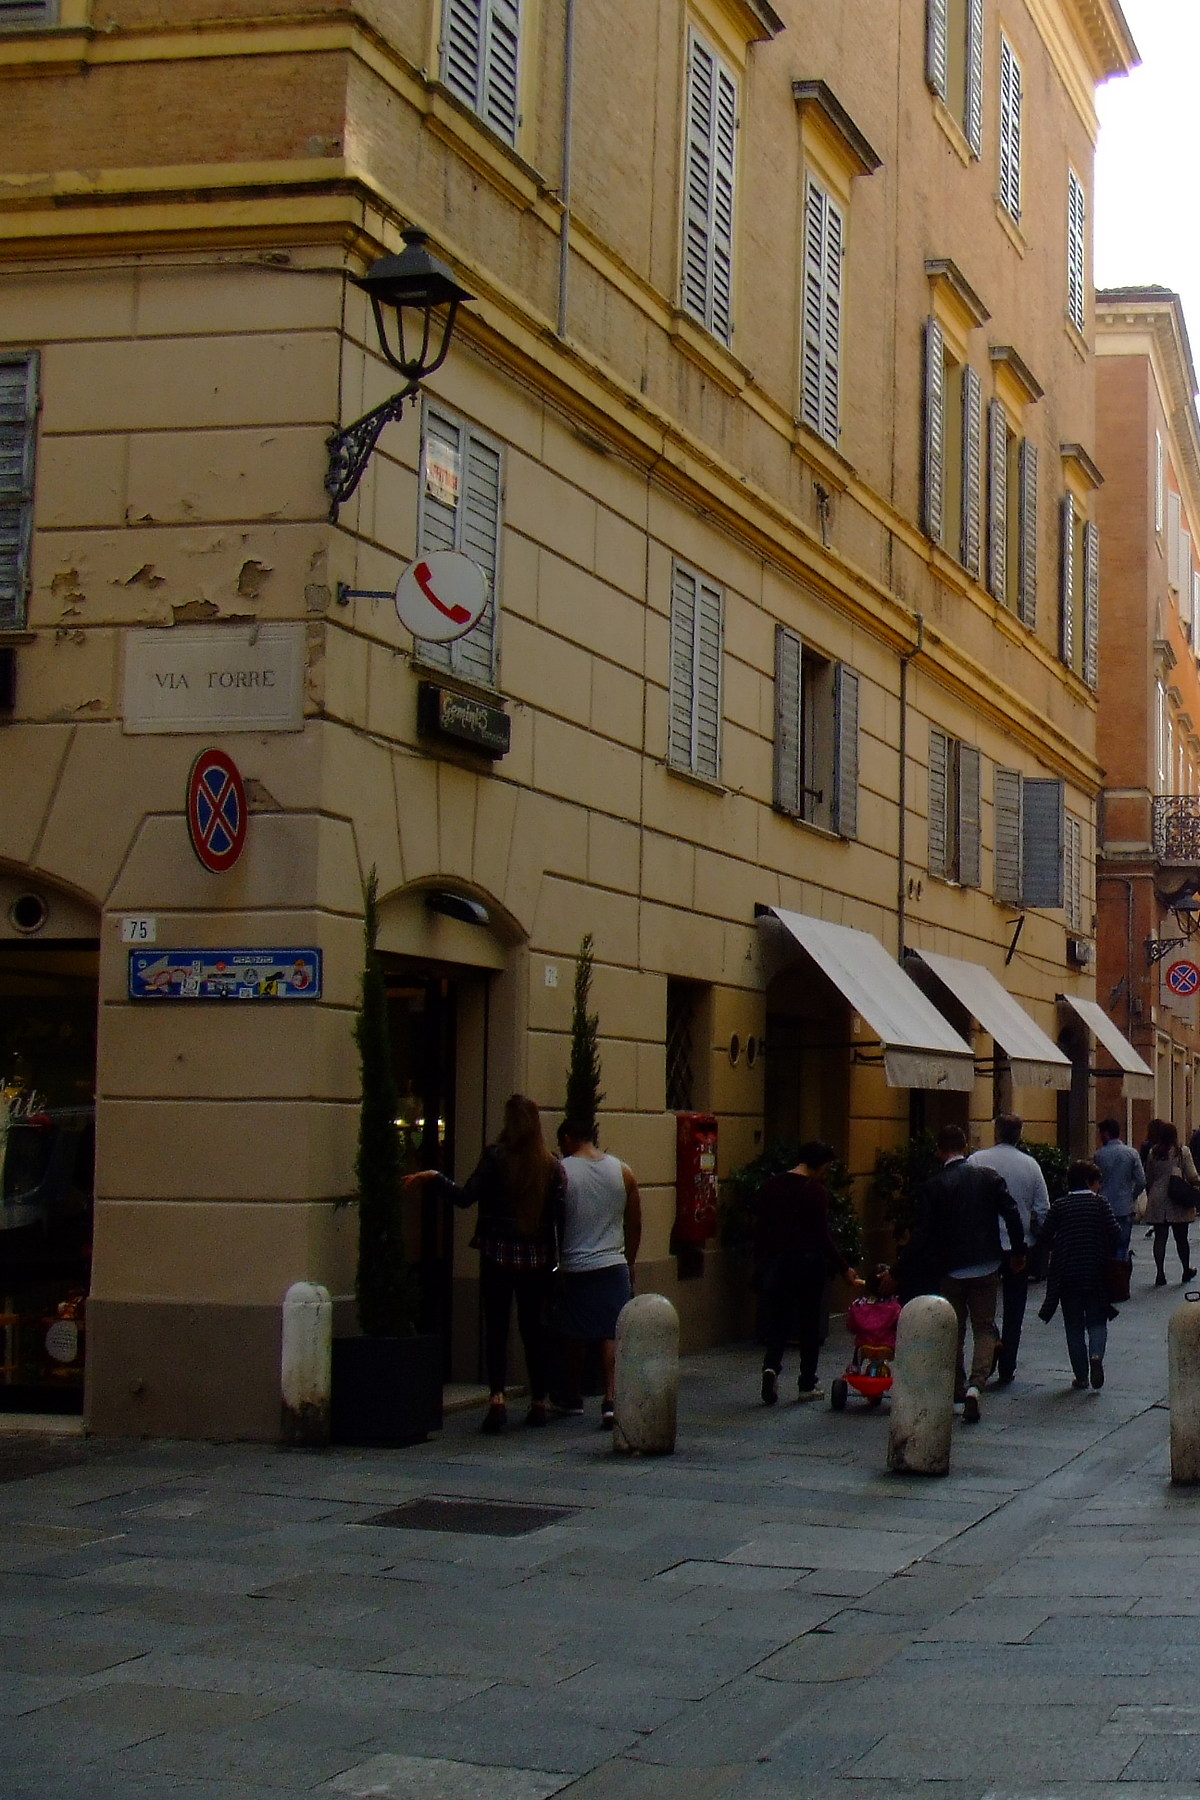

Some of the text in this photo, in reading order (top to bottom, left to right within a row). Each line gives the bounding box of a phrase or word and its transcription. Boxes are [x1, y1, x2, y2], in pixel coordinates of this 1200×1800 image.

[155, 670, 276, 689] VIA TORRE
[129, 921, 148, 939] 75
